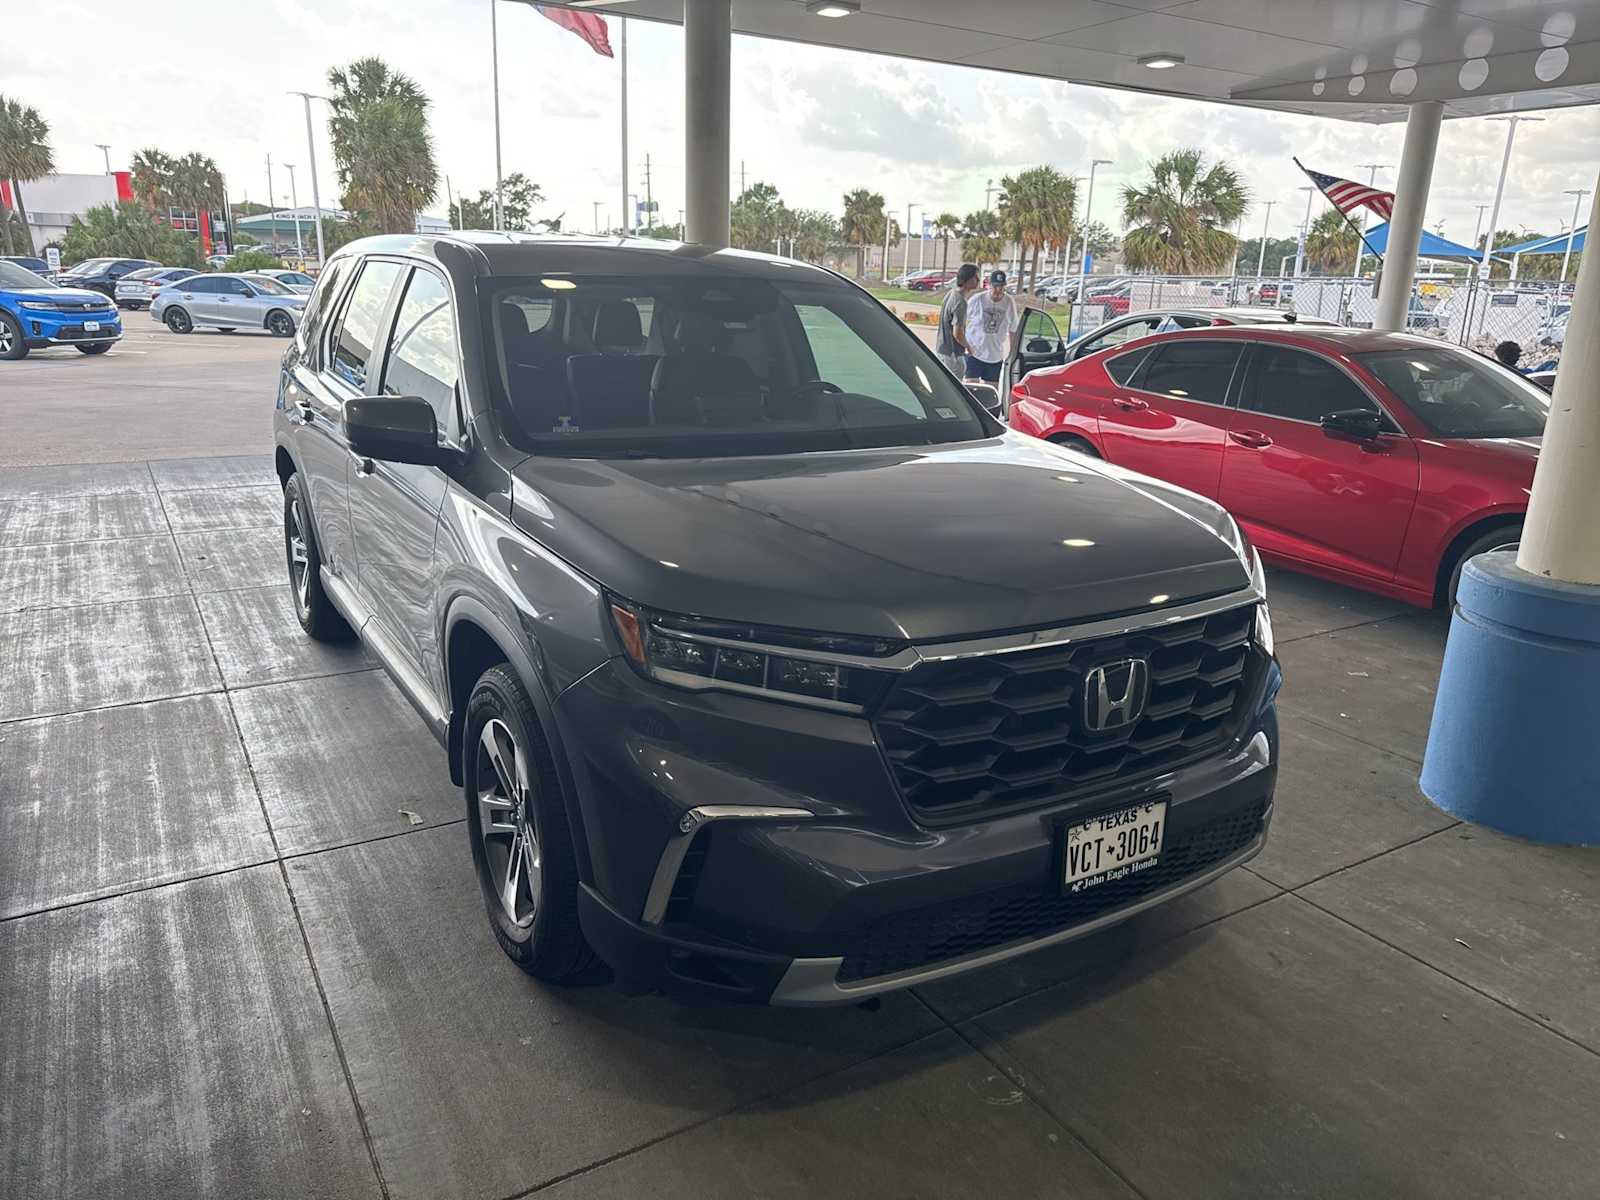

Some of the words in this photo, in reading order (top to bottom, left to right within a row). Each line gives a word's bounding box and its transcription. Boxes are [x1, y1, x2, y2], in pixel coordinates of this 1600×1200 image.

[1098, 809, 1138, 832] TEXAS
[1069, 838, 1105, 876] VCT
[1116, 820, 1160, 862] 3064
[1083, 877, 1105, 890] John
[1107, 865, 1130, 881] Eagle
[1131, 856, 1158, 874] Honda
